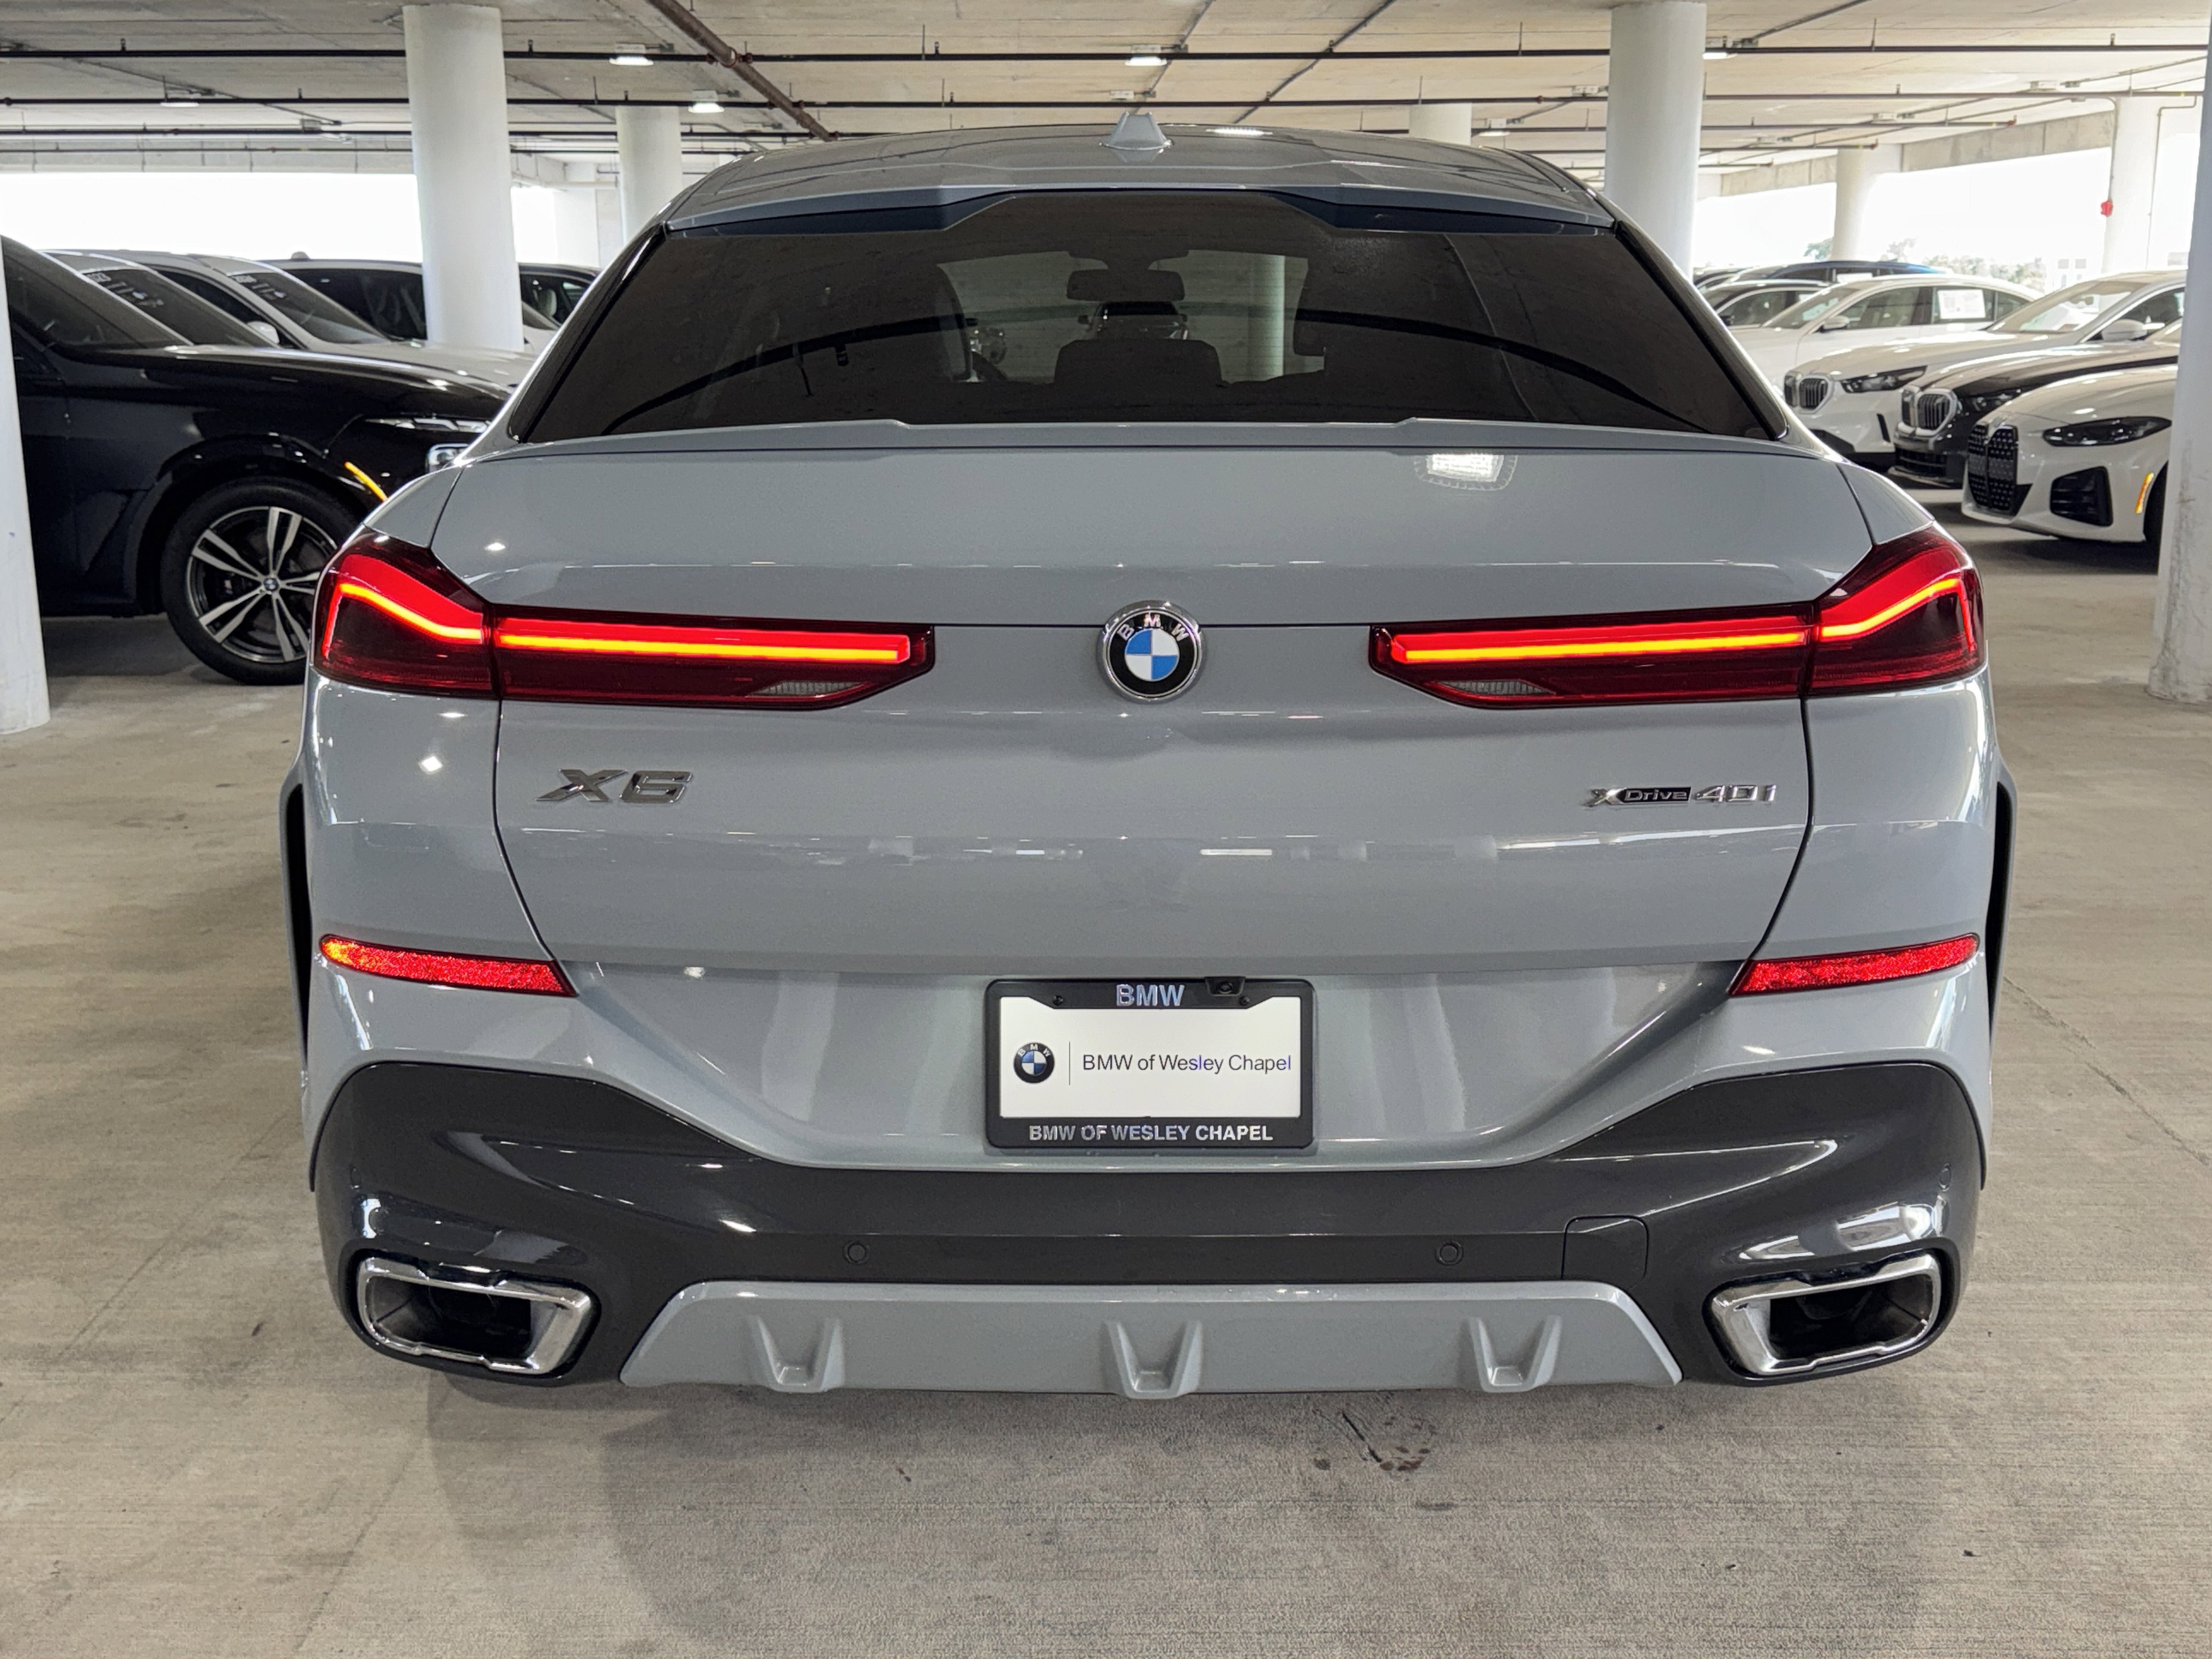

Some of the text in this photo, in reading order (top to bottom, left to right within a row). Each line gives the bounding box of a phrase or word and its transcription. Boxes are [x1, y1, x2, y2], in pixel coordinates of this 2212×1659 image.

[1117, 614, 1189, 641] BMW
[535, 769, 693, 803] X6
[1116, 984, 1185, 1006] BMW
[1018, 1043, 1051, 1057] BMW
[1083, 1054, 1291, 1075] BMW of Wesley Chapel
[1029, 1125, 1273, 1141] BMW OF WESLEY CHAPEL
